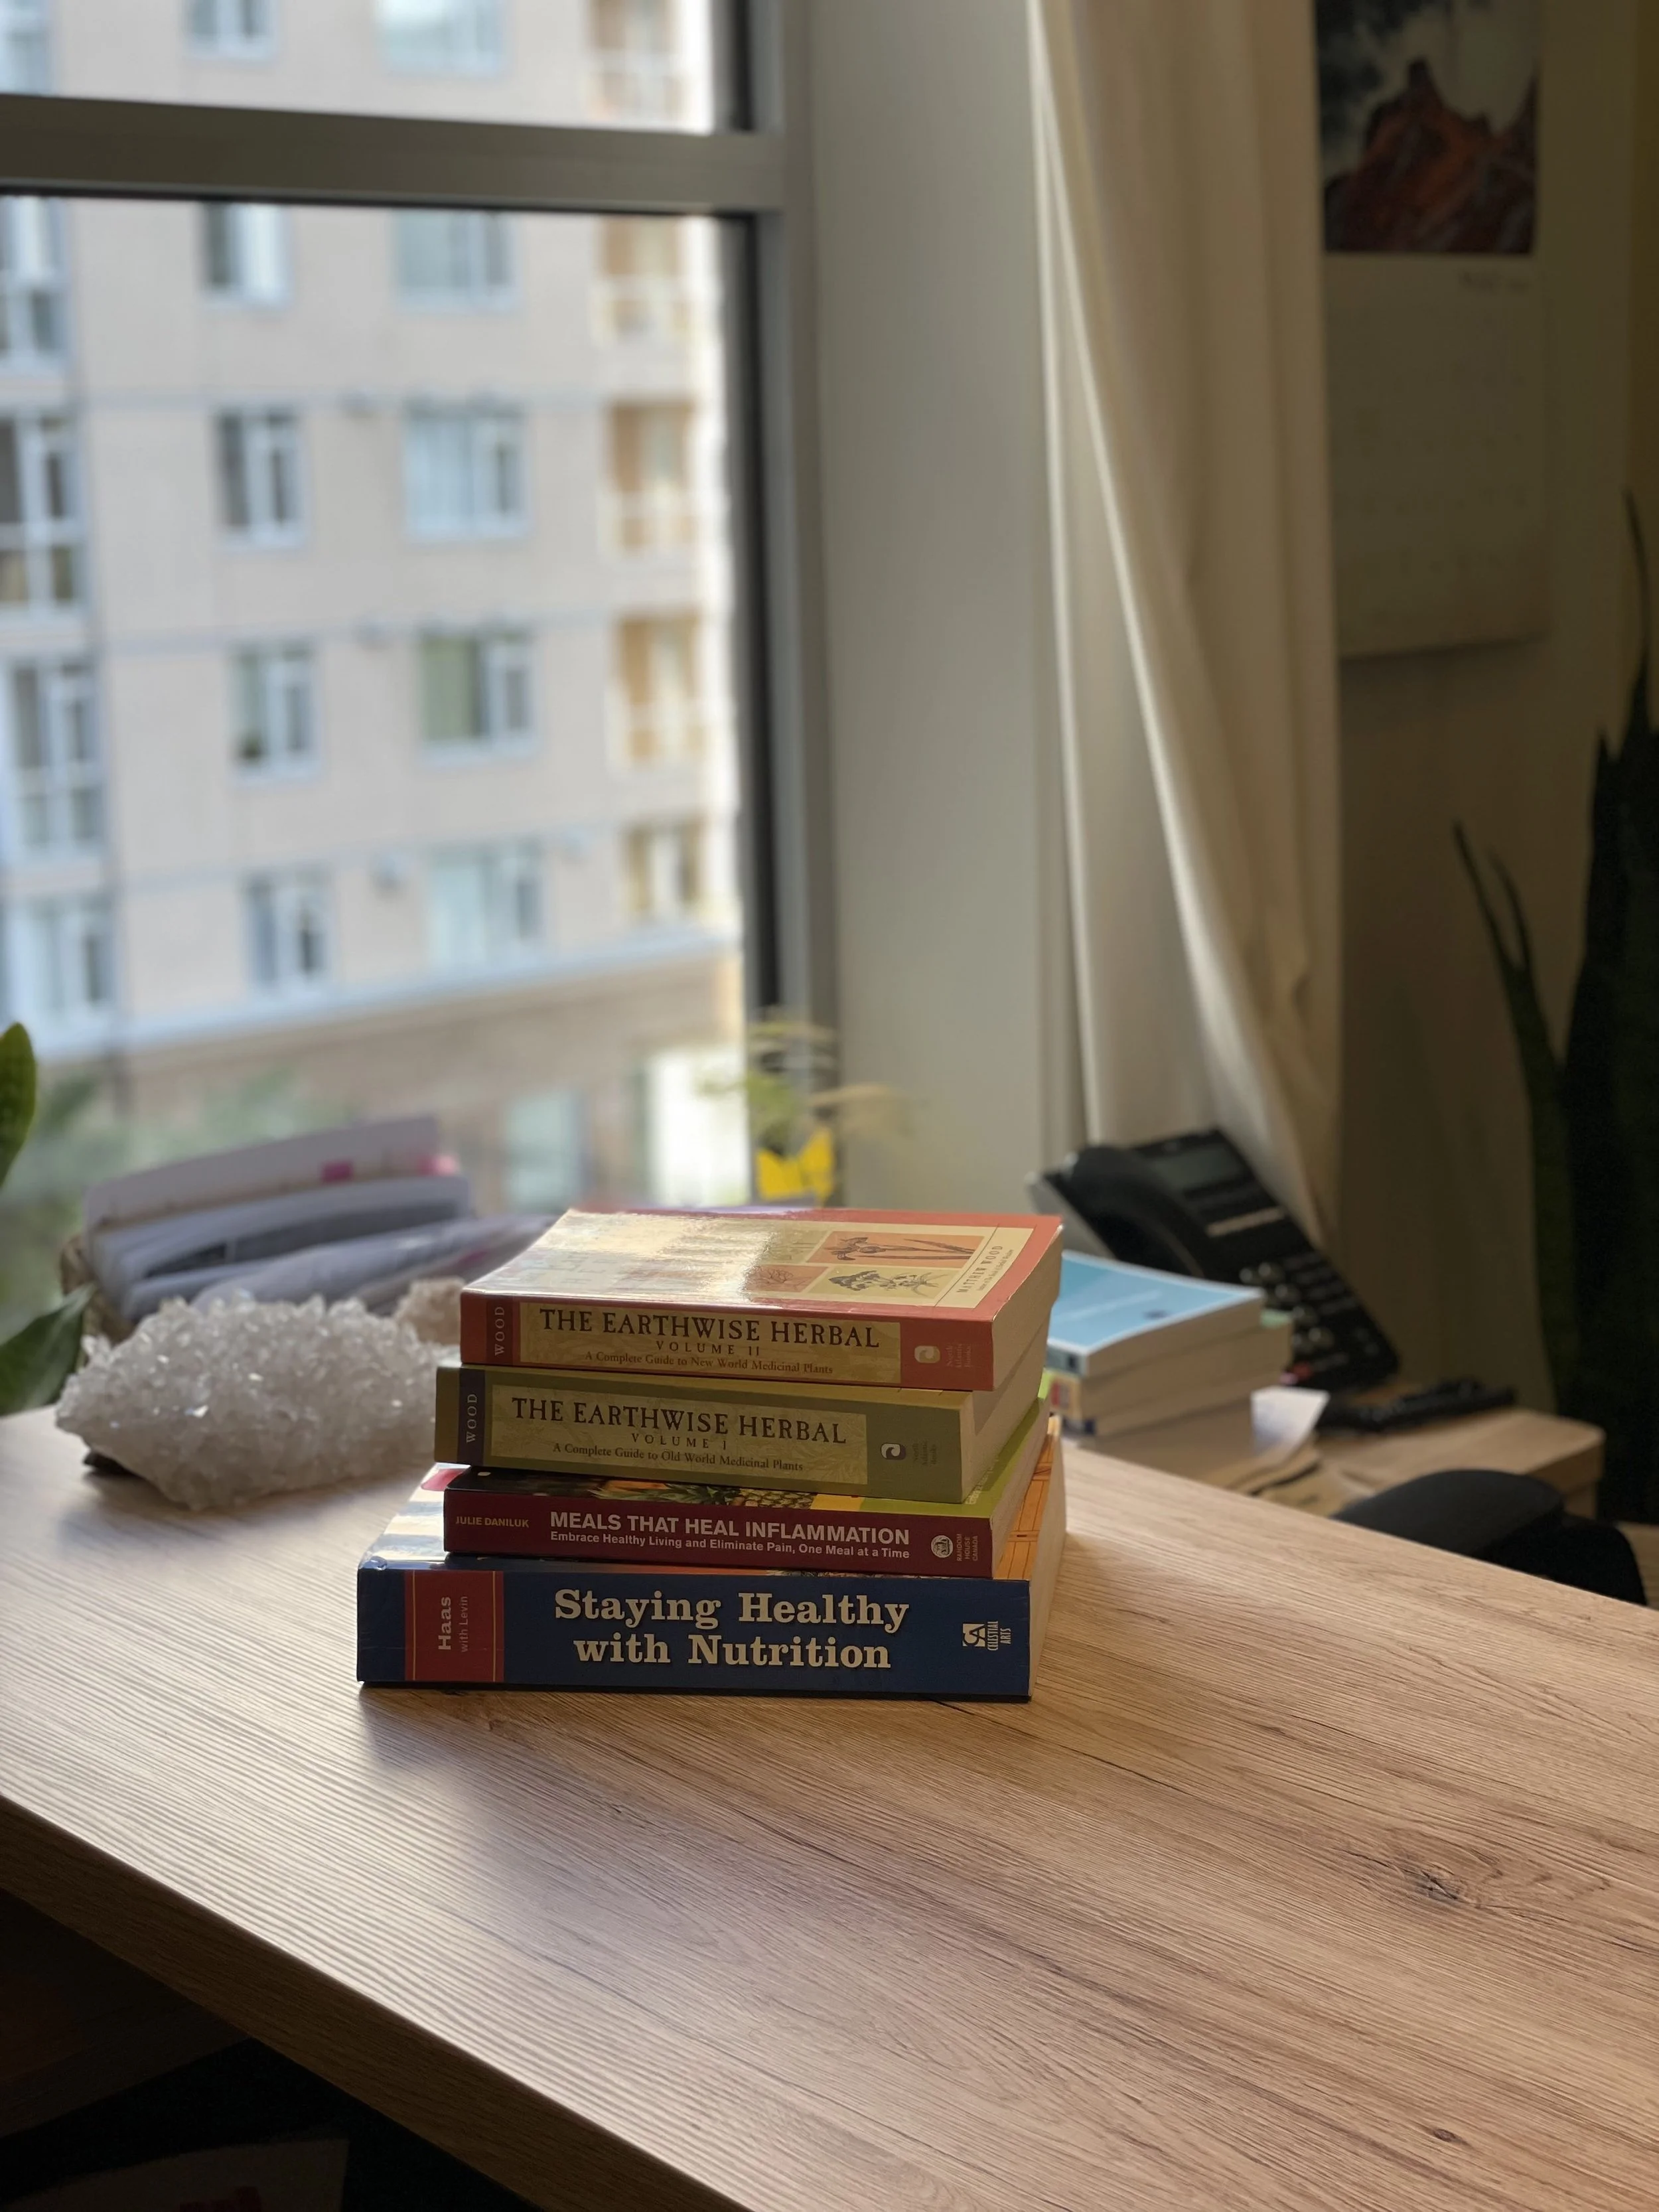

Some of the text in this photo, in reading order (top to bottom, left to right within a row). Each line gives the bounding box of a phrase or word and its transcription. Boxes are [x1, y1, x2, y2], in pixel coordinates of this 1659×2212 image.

[956, 1268, 986, 1293] MATTHEW
[981, 1246, 1003, 1264] WOOD
[494, 1306, 505, 1356] WOOD
[540, 1308, 879, 1348] THE EARTHWISE HERBAL
[585, 1352, 833, 1374] A Complete Guide to New World Medicinal Plants
[656, 1341, 760, 1356] VOLUME II
[466, 1394, 477, 1443] WOOD
[512, 1397, 846, 1443] THE EARTHWISE HERBAL
[553, 1443, 803, 1471] A Complete Guide to Old World Medicinal Plants
[632, 1433, 727, 1450] VOLUME I
[455, 1516, 530, 1528] JULIE DANILUK
[551, 1511, 910, 1545] MEALS THAT HEAL INFLAMMATION
[551, 1531, 600, 1543] Embrace
[603, 1534, 646, 1547] Healthy
[649, 1536, 682, 1549] Living
[685, 1537, 706, 1548] and
[710, 1538, 764, 1551] Eliminate
[767, 1542, 796, 1554] Pain,
[798, 1543, 822, 1554] One
[825, 1545, 854, 1556] Meal
[857, 1547, 869, 1556] at
[881, 1548, 910, 1558] Time
[438, 1596, 451, 1651] Haas
[459, 1595, 469, 1653] with Levin
[554, 1589, 910, 1633] Staying Healthy
[573, 1632, 891, 1668] with Nutrition
[987, 1621, 998, 1651] CELESTIAL
[999, 1628, 1011, 1645] ARTS
